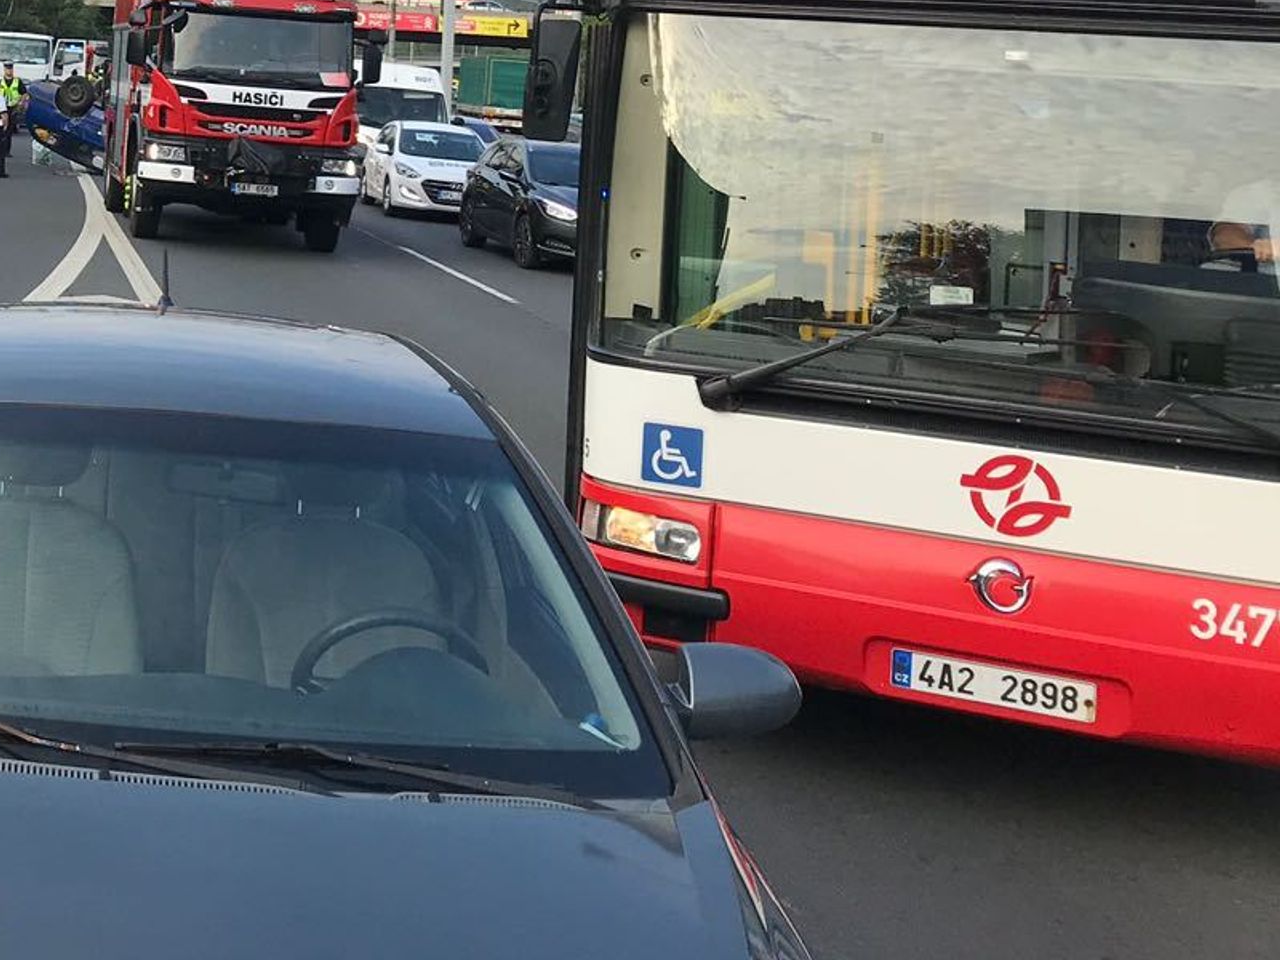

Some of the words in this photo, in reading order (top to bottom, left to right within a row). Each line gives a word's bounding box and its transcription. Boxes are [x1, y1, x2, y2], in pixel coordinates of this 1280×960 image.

[232, 91, 284, 106] HASIČI
[222, 121, 288, 137] SCANIA
[1190, 598, 1280, 648] 347
[919, 660, 974, 695] 4A2
[1000, 675, 1078, 713] 2898
